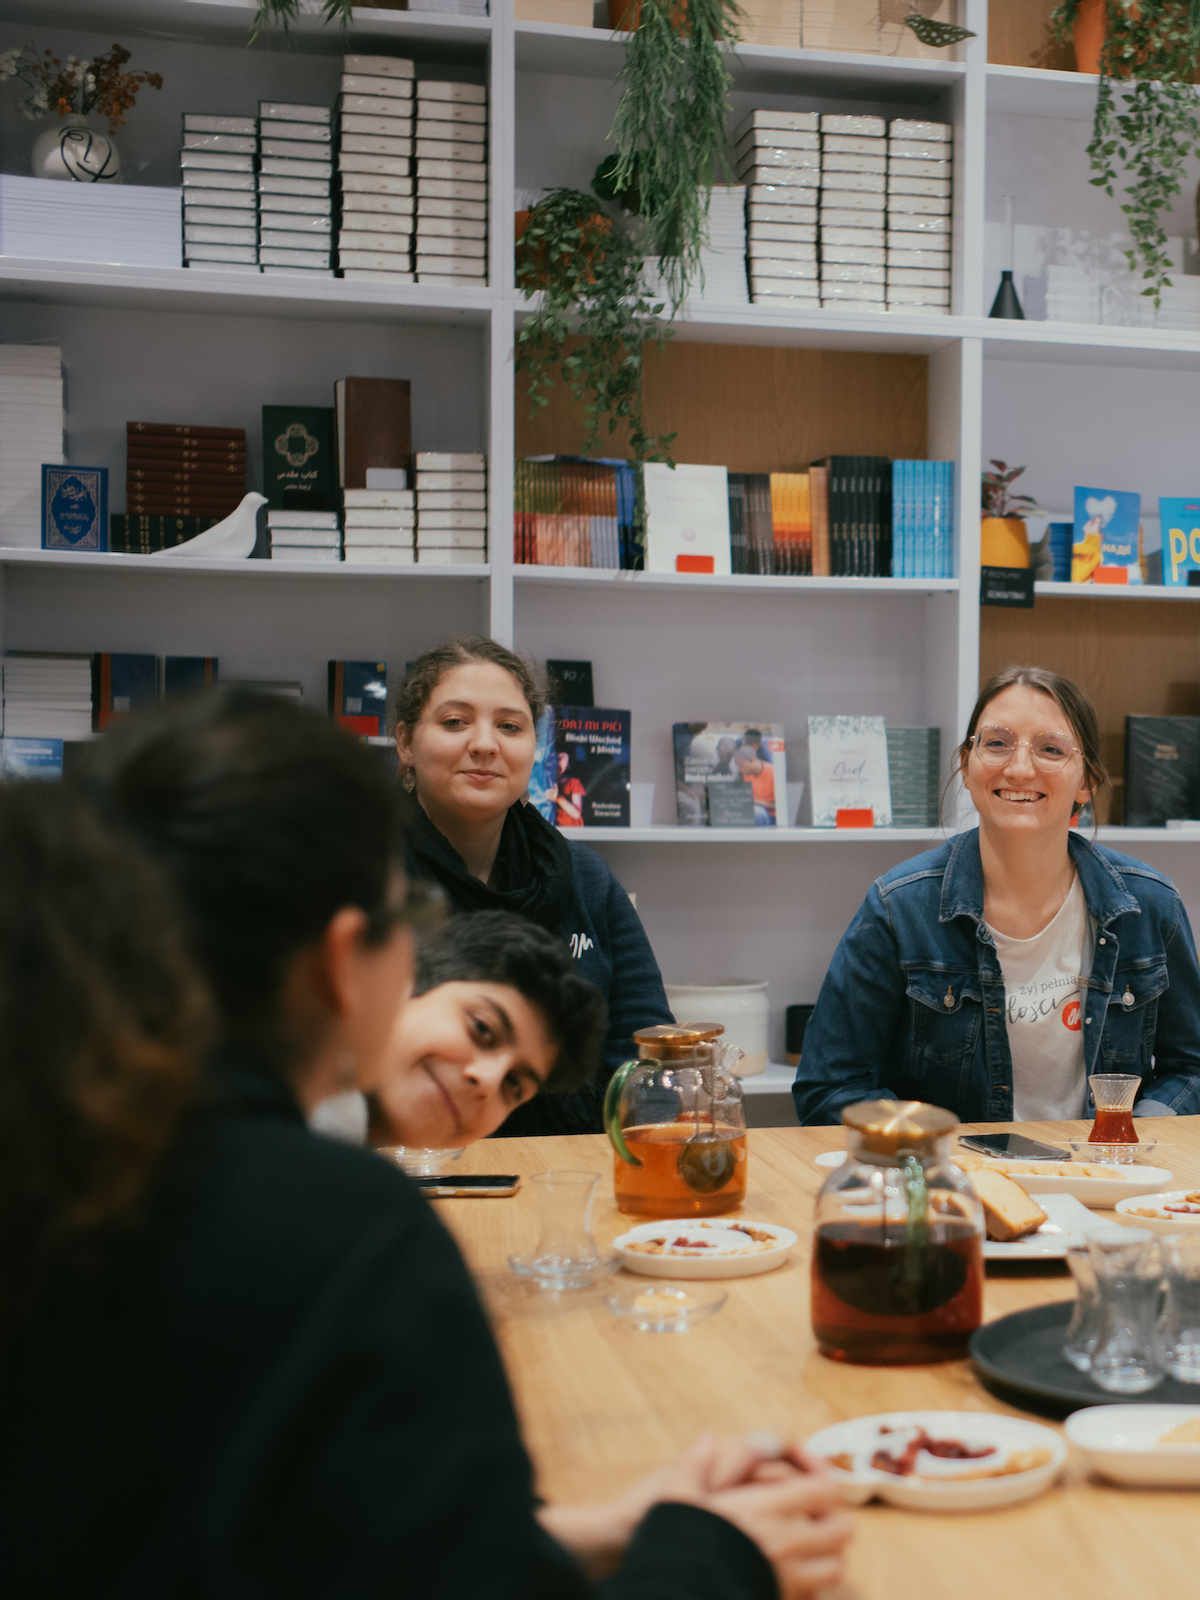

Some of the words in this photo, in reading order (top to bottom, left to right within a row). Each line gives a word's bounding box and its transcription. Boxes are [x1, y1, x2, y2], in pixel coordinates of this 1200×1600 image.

[562, 719, 582, 730] DAJ
[1020, 982, 1038, 995] żyj
[1040, 975, 1077, 993] pełnią
[1006, 989, 1080, 1024] łości
